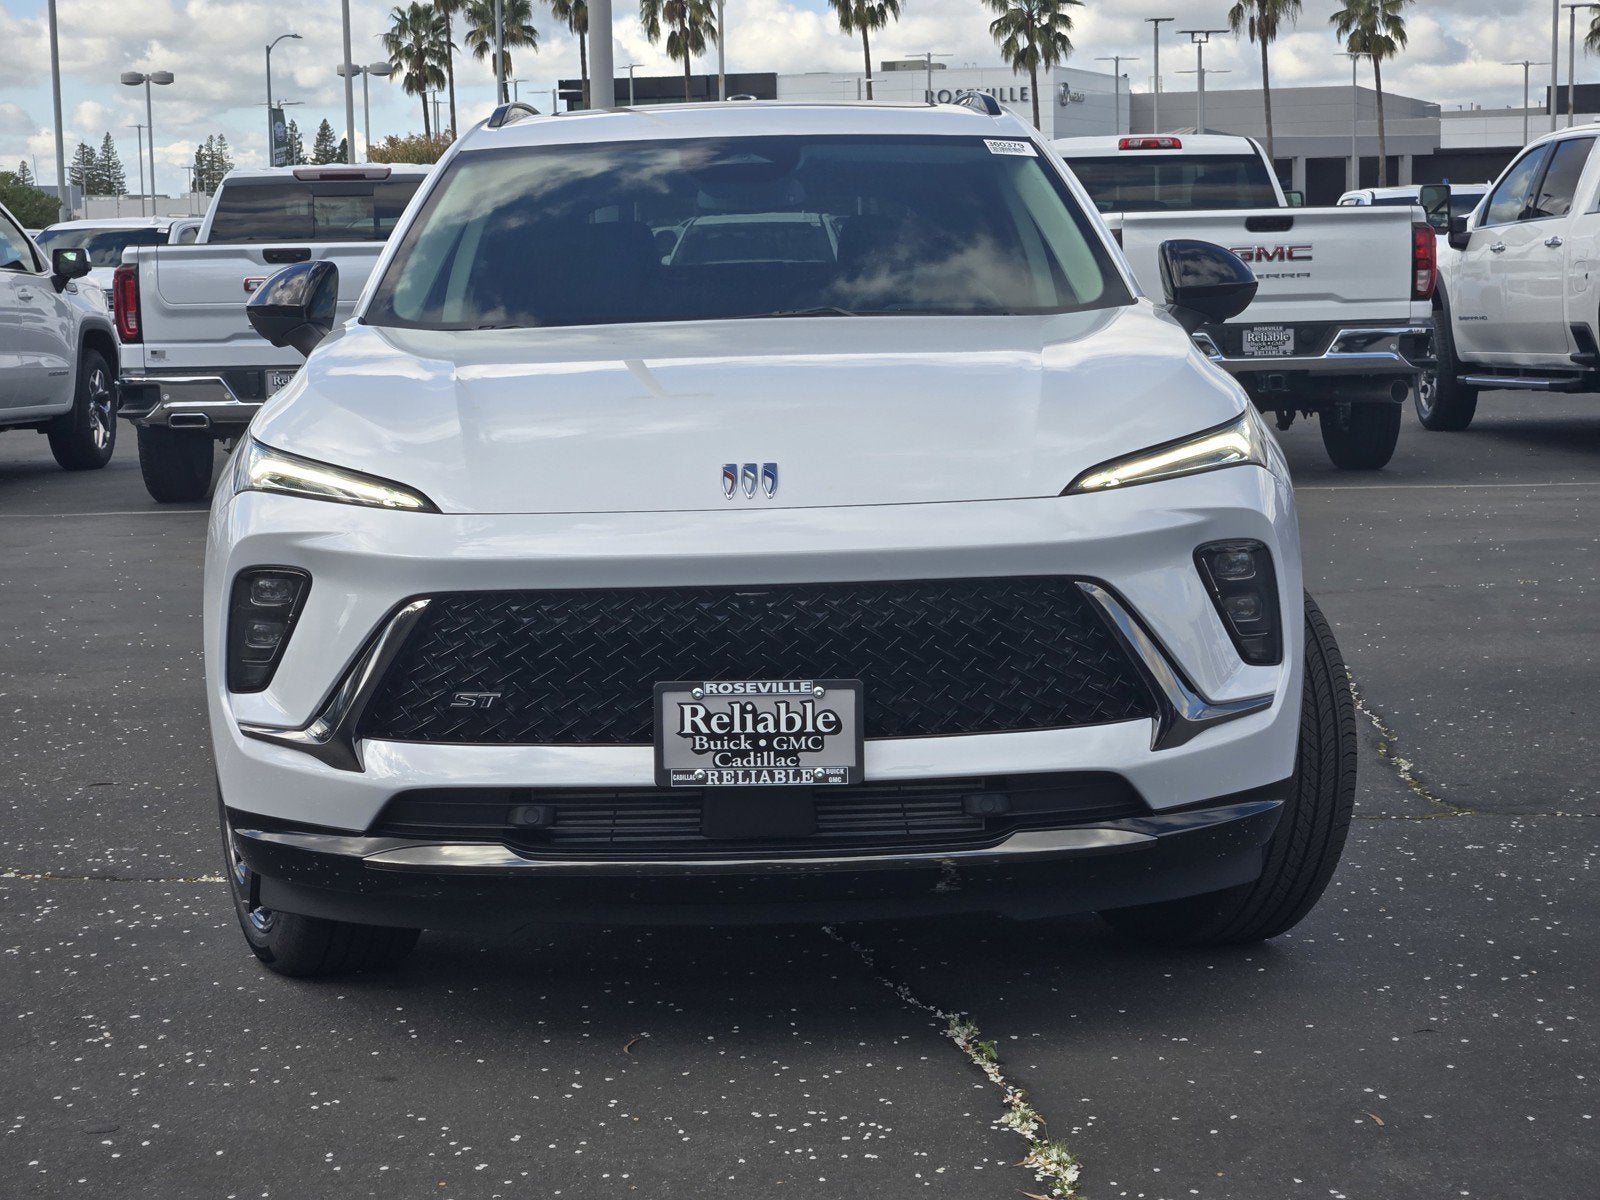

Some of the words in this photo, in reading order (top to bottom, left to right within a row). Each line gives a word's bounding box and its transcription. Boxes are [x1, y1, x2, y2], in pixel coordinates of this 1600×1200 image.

[925, 87, 1029, 104] ROILLE
[1229, 245, 1313, 262] GMC
[1247, 331, 1290, 342] Reliable
[705, 681, 812, 695] ROSEVILLE
[450, 692, 501, 708] ST
[679, 700, 838, 735] Reliable
[693, 735, 753, 750] Buick
[773, 735, 823, 750] GMC
[714, 752, 797, 767] Cadillac
[706, 769, 814, 785] RELIABLE
